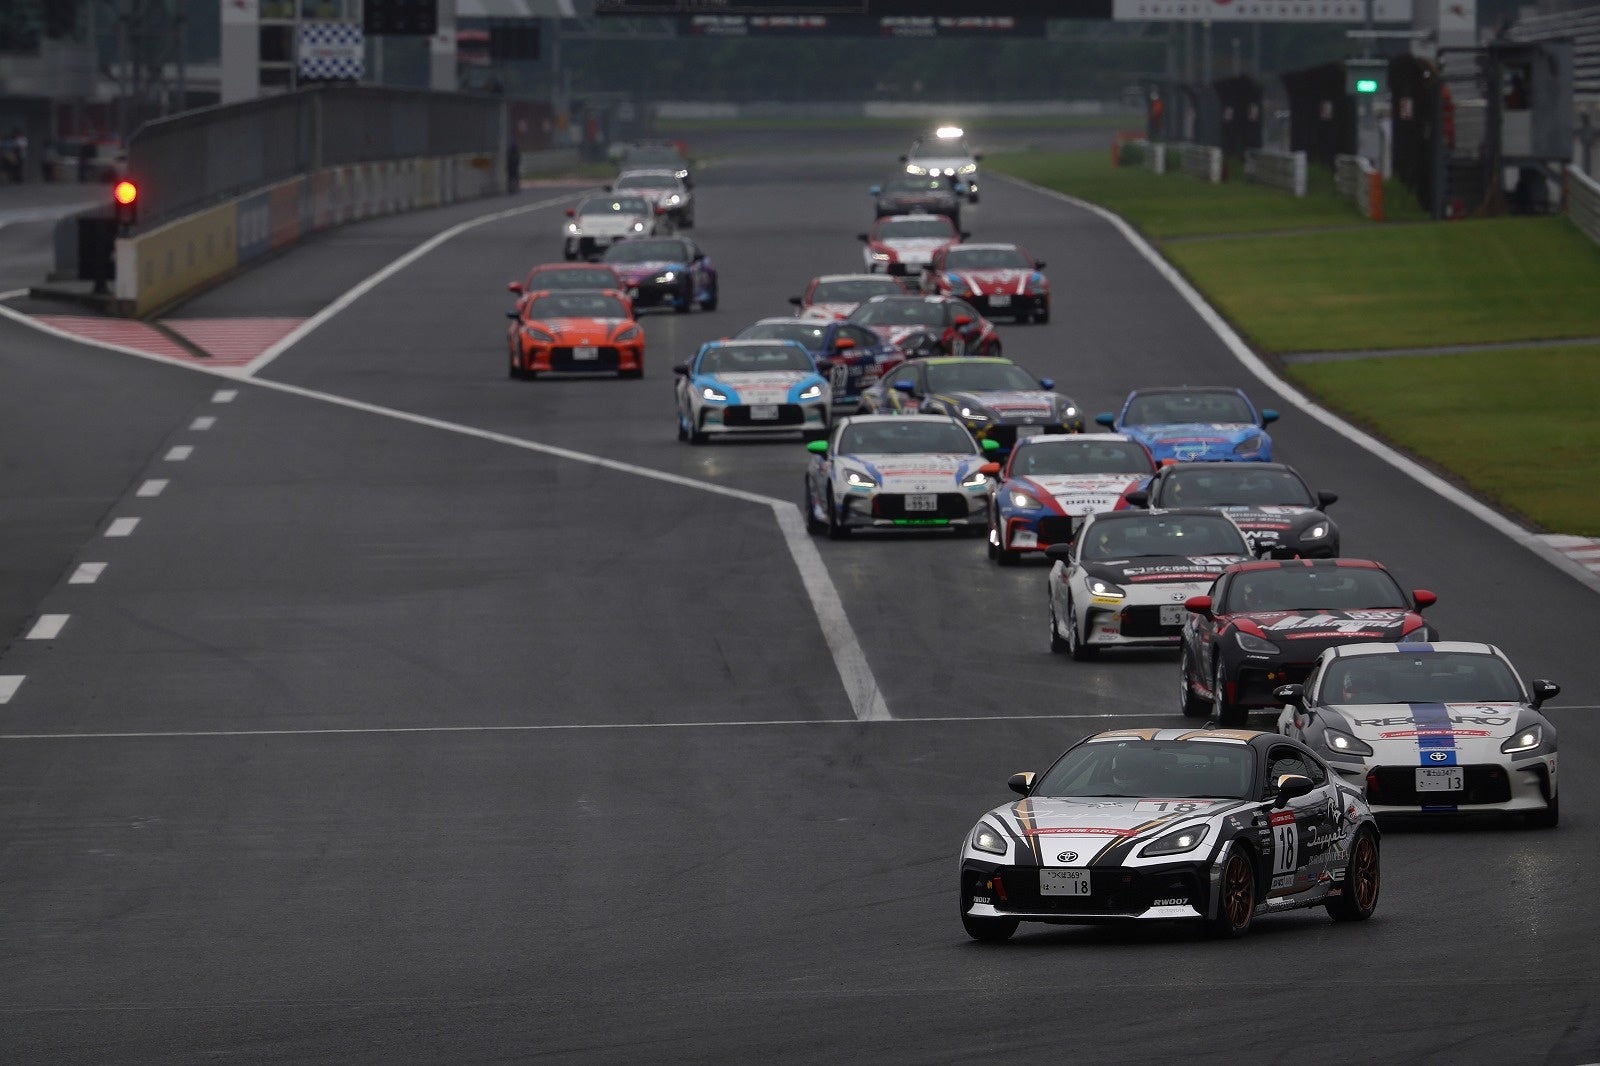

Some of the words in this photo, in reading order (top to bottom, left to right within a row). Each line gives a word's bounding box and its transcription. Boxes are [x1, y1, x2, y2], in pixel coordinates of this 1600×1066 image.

[1475, 706, 1499, 714] 3
[1154, 802, 1198, 812] 18
[1279, 827, 1294, 870] 18
[1074, 880, 1088, 894] 18
[1153, 898, 1189, 906] RW007
